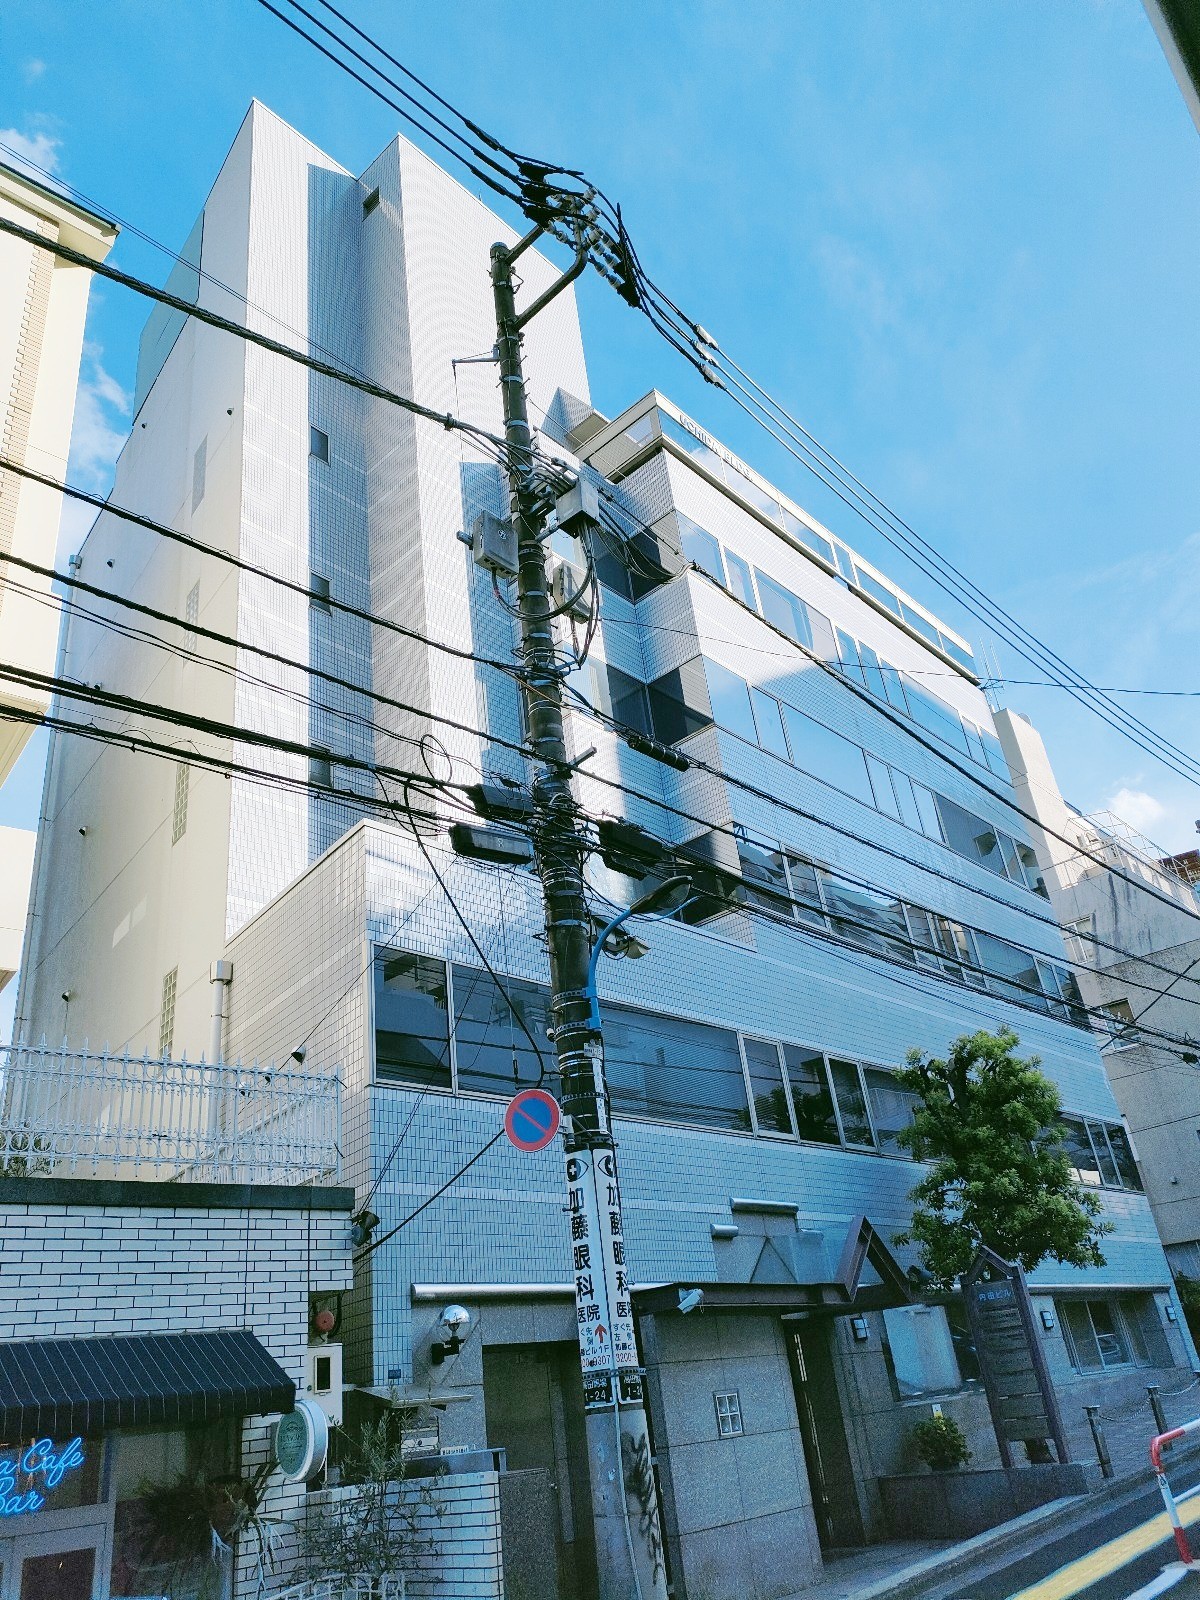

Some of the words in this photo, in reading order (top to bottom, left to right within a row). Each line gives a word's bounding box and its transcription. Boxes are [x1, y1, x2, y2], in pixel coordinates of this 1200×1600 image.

[568, 1187, 594, 1303] 加藤眼科
[23, 1437, 85, 1487] Cafe
